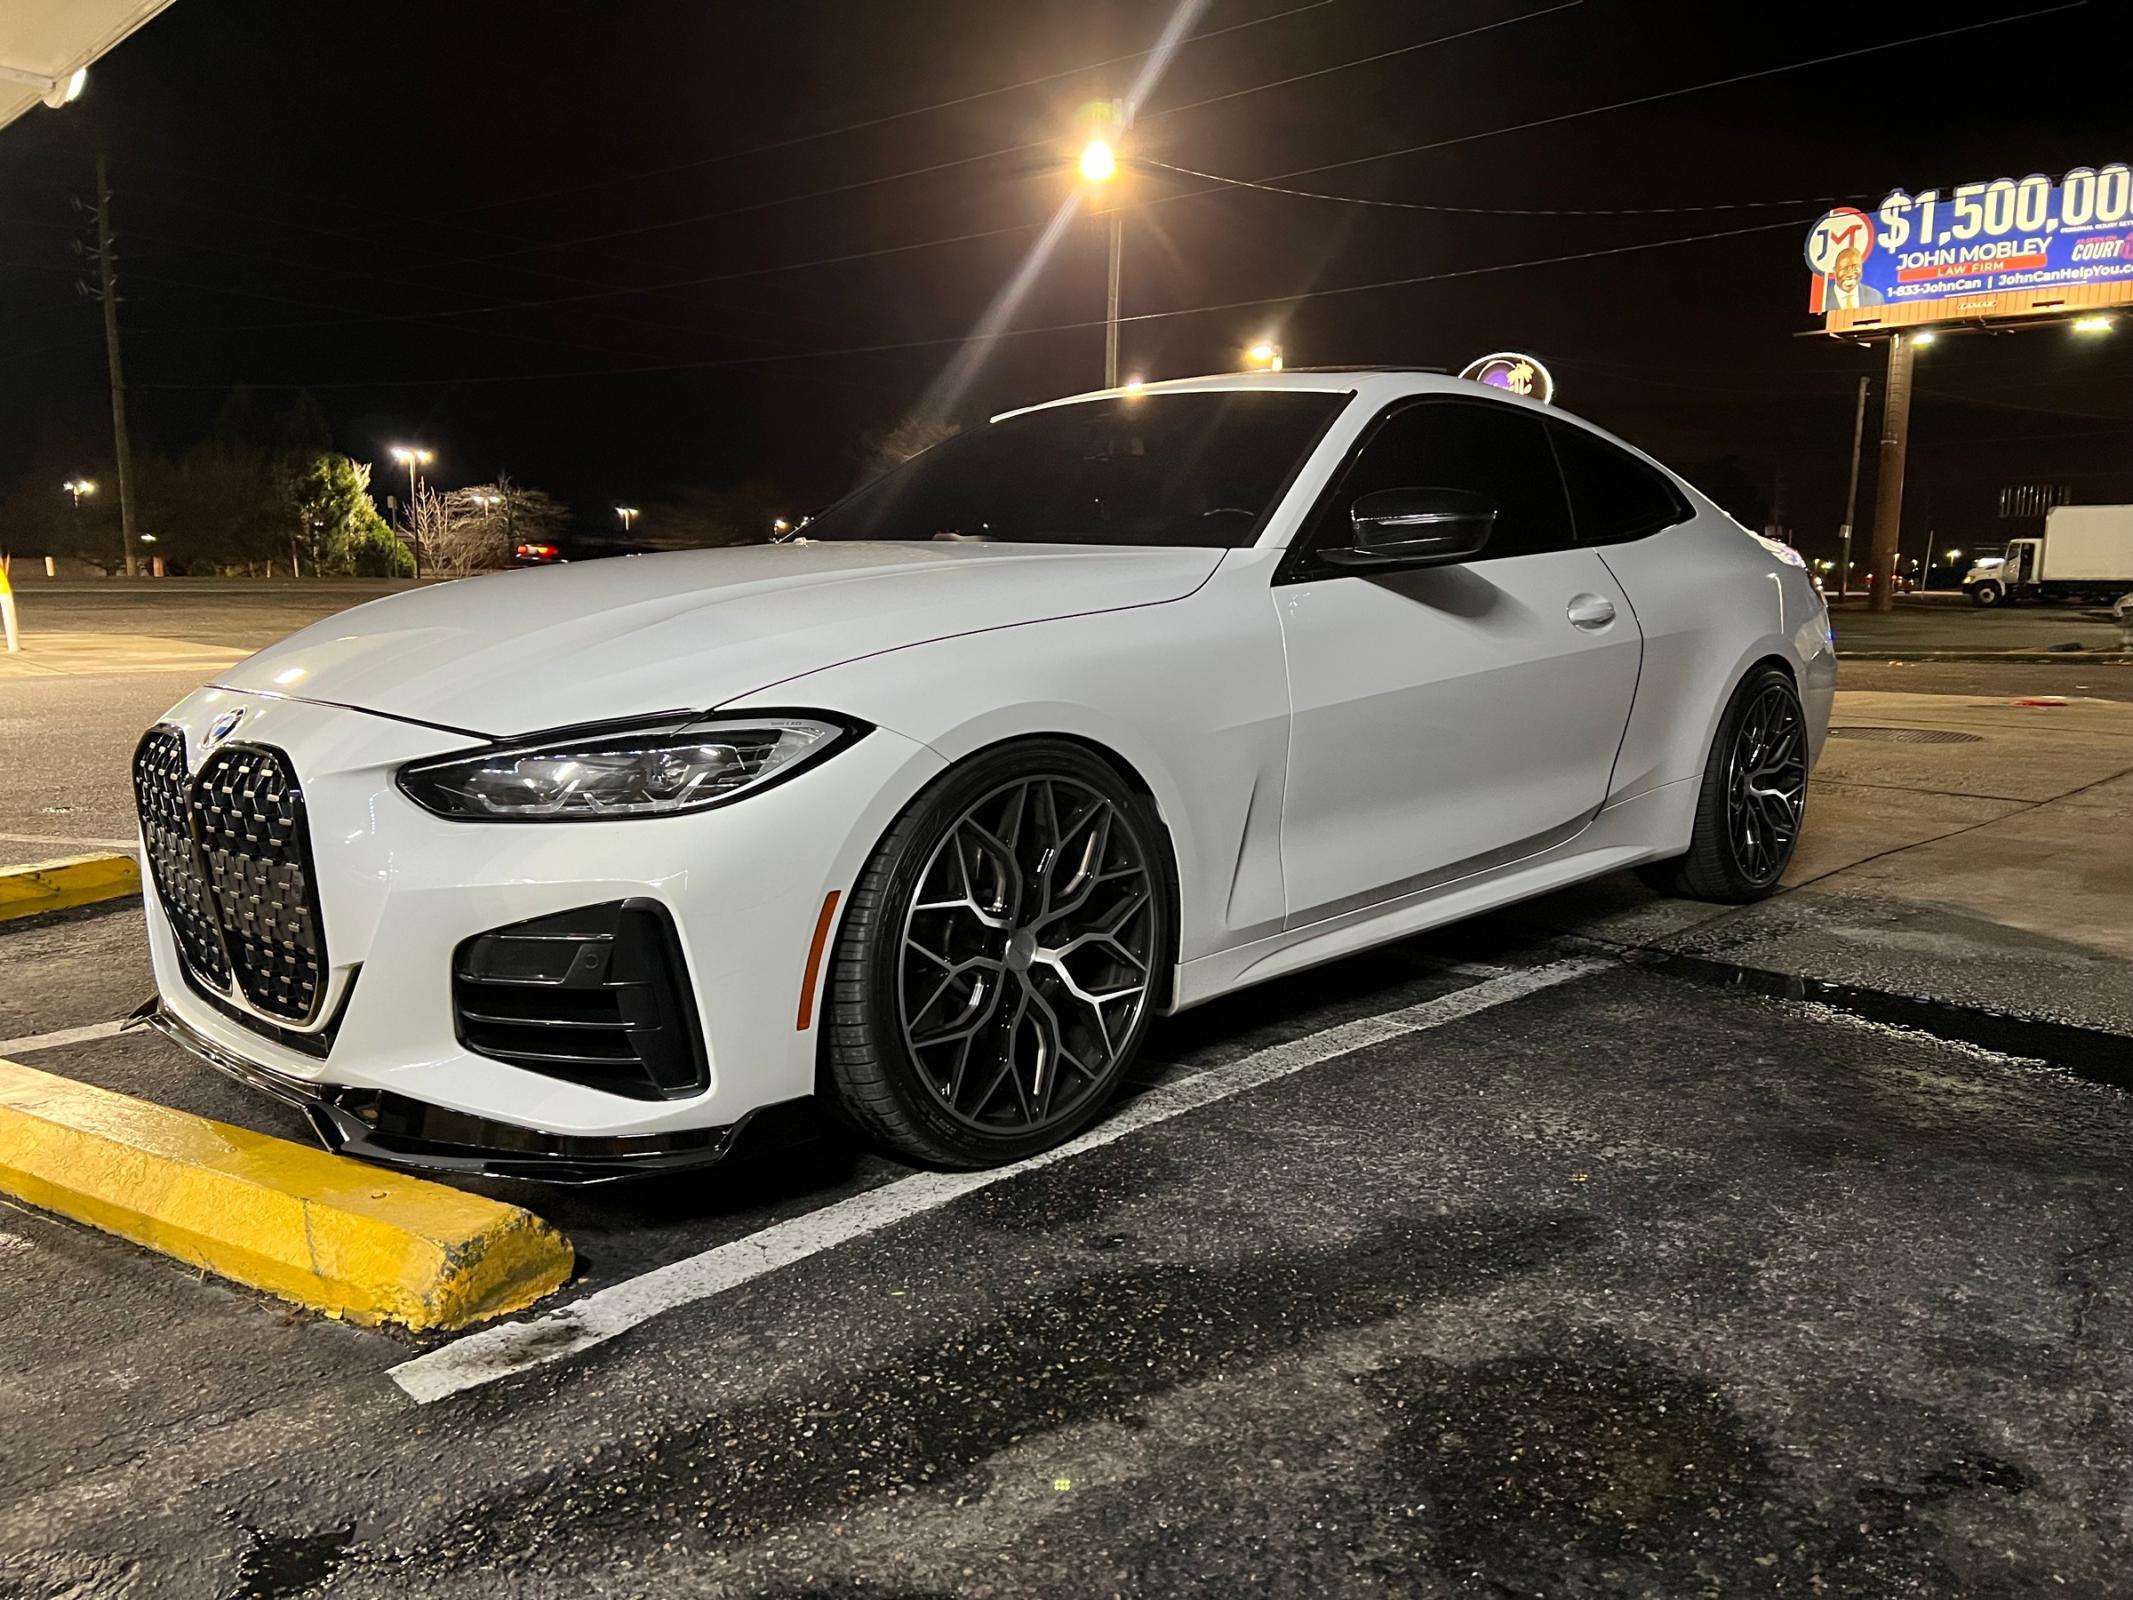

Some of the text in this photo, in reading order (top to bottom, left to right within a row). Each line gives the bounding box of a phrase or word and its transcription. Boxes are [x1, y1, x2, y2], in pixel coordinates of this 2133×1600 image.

[1877, 165, 2133, 254] $1,500,00
[1896, 236, 2053, 271] JOHN MOBLEY
[2071, 239, 2125, 262] COURT
[1887, 278, 1982, 298] 1-833-JohnCan
[1999, 263, 2133, 287] JohnCanHelpYou.c
[1937, 261, 2005, 278] LAW FIRM
